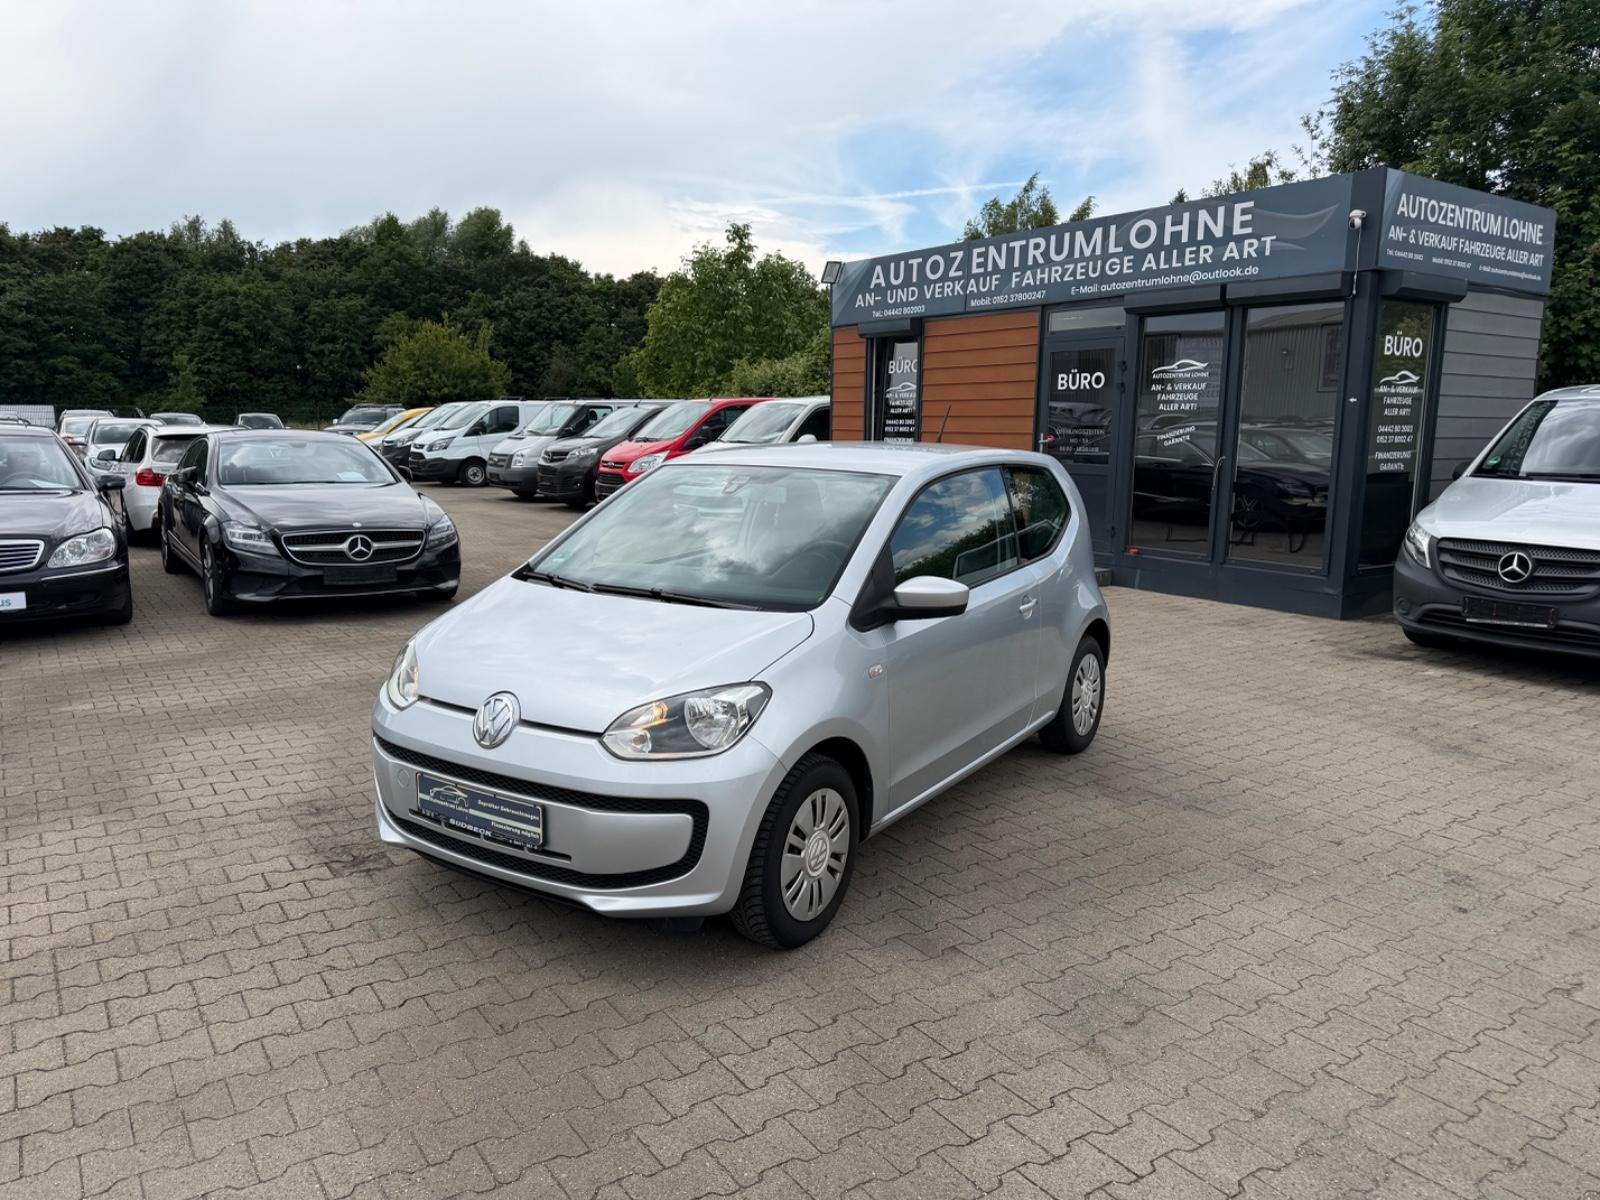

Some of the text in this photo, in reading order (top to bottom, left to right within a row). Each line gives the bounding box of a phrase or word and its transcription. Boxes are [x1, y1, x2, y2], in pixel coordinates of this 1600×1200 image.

[1397, 193, 1544, 245] AUTOZENTRUM LOHNE
[1388, 225, 1545, 267] AN- & VERKAUF FAHRZEUGE ALLER ART
[855, 235, 1277, 308] AN- UND VERKAUF FAHRZEUGE ALLER ART
[1101, 265, 1260, 291] autozentrumlohne@outlook.de
[993, 295, 1008, 304] 0152
[1009, 289, 1047, 302] 37800247
[884, 307, 902, 316] 04442
[1384, 331, 1423, 357] BÜRO
[1057, 368, 1106, 391] BÜRO
[1151, 383, 1165, 391] AN-
[1173, 382, 1207, 390] VERKAUF
[1157, 392, 1199, 401] FAHRZEUGE
[1384, 396, 1412, 405] FAHRZEUGE
[1158, 402, 1198, 411] ALLER ART!
[1384, 407, 1399, 416] ALLER
